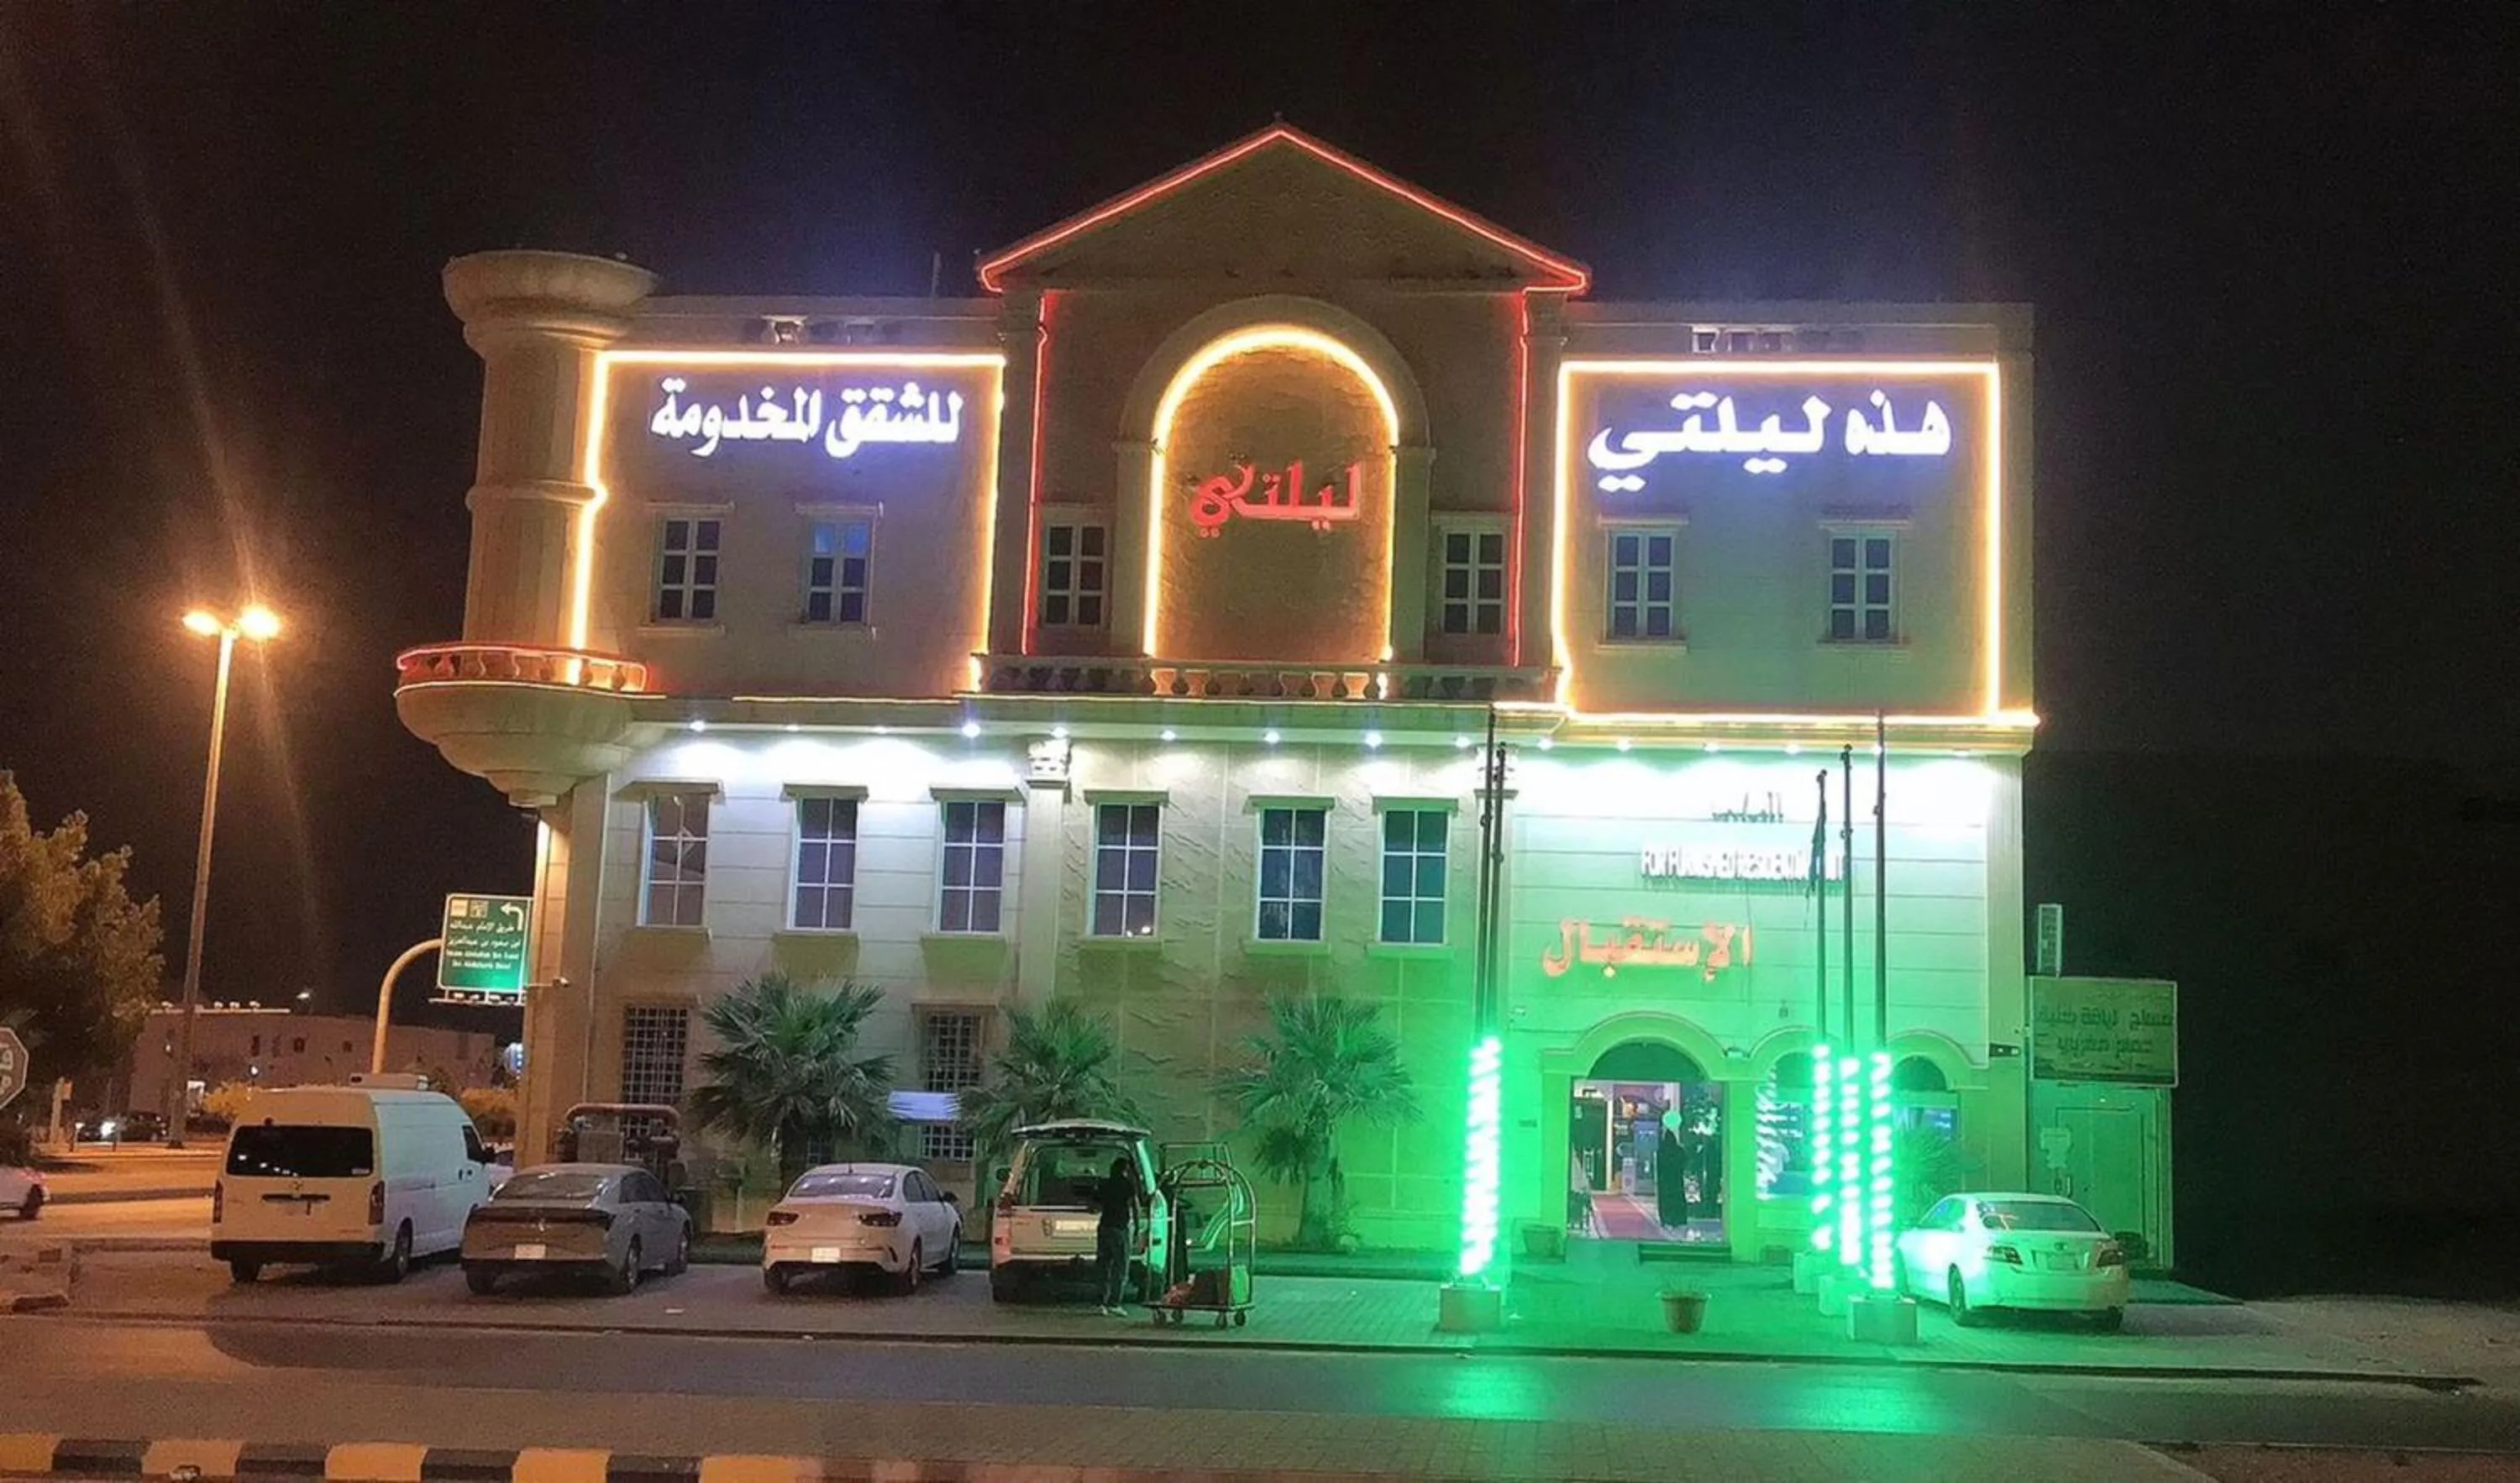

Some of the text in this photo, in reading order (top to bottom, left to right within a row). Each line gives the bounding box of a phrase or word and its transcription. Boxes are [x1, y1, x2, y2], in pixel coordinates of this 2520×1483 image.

[650, 377, 963, 459] للشقق المخدومة
[1588, 389, 1952, 492] هذه ليلتي
[1542, 914, 1752, 983] الإستقبال
